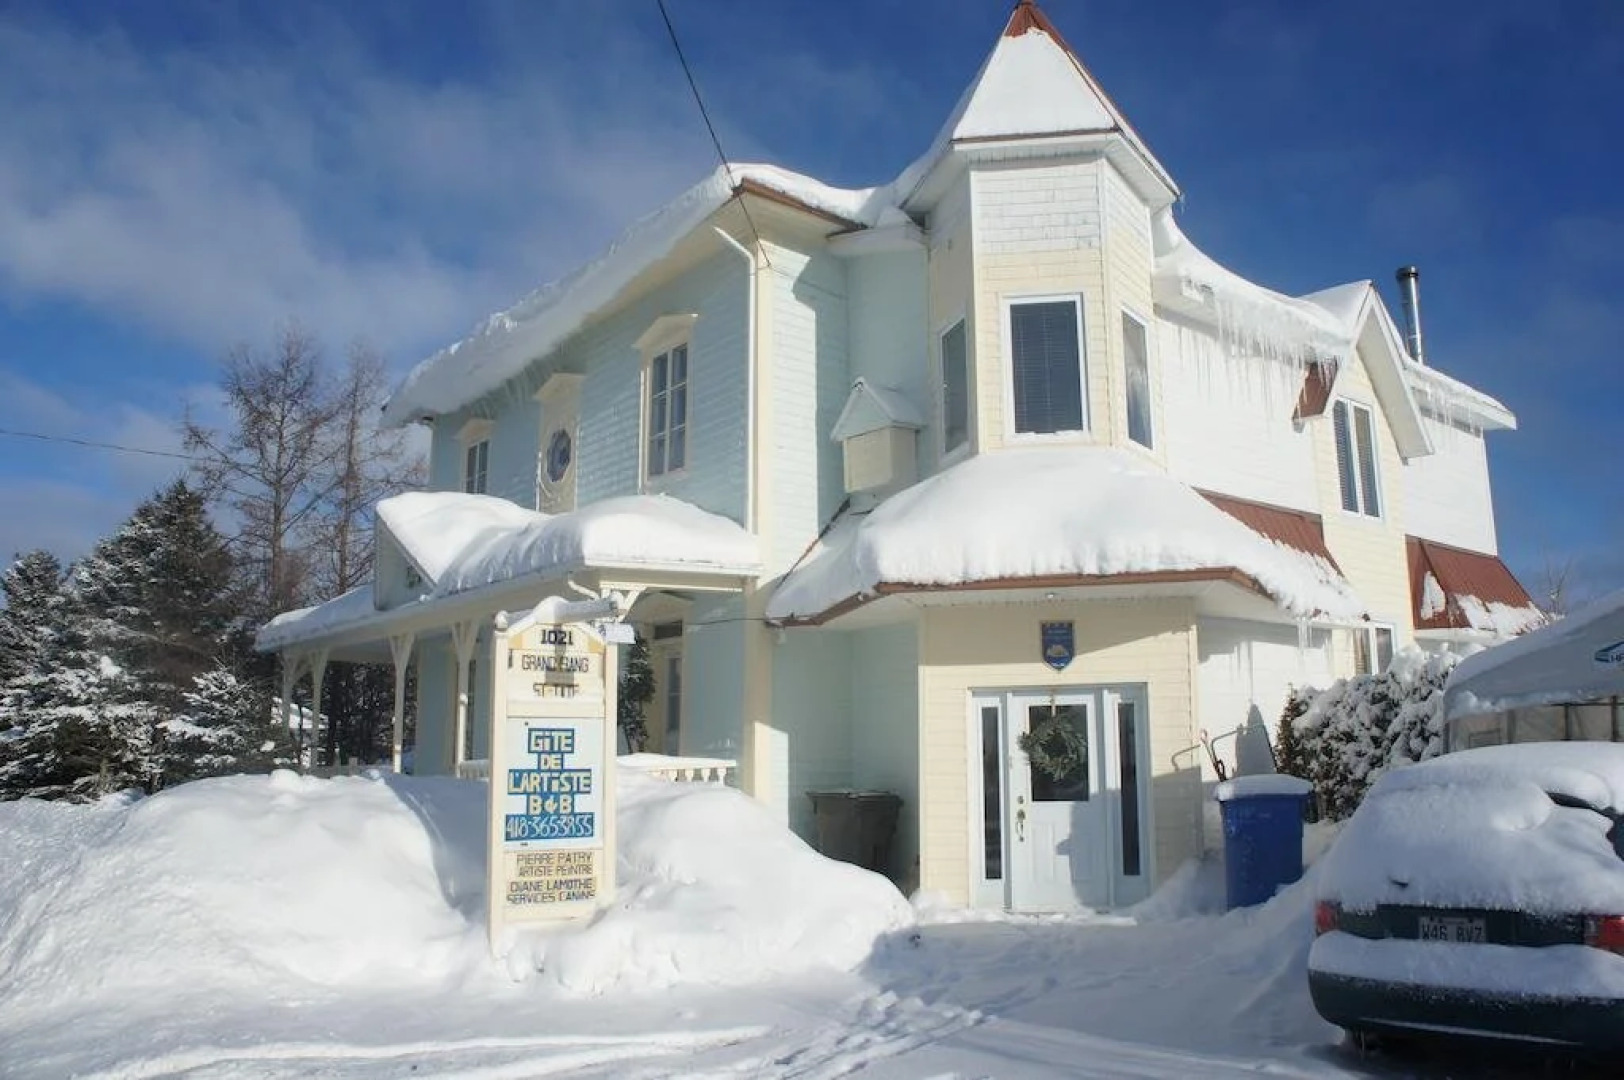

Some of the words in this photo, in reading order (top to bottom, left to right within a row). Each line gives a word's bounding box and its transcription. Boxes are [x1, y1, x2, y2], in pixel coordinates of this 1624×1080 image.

[540, 629, 574, 645] 1021
[521, 654, 556, 671] GRAND
[540, 754, 562, 770] DE
[516, 853, 554, 865] PIERRE
[557, 851, 592, 863] PATRY
[556, 864, 592, 875] PEINTRE
[510, 880, 543, 892] DIANE
[547, 878, 592, 890] LAMOTHE
[507, 893, 556, 904] SERVICES
